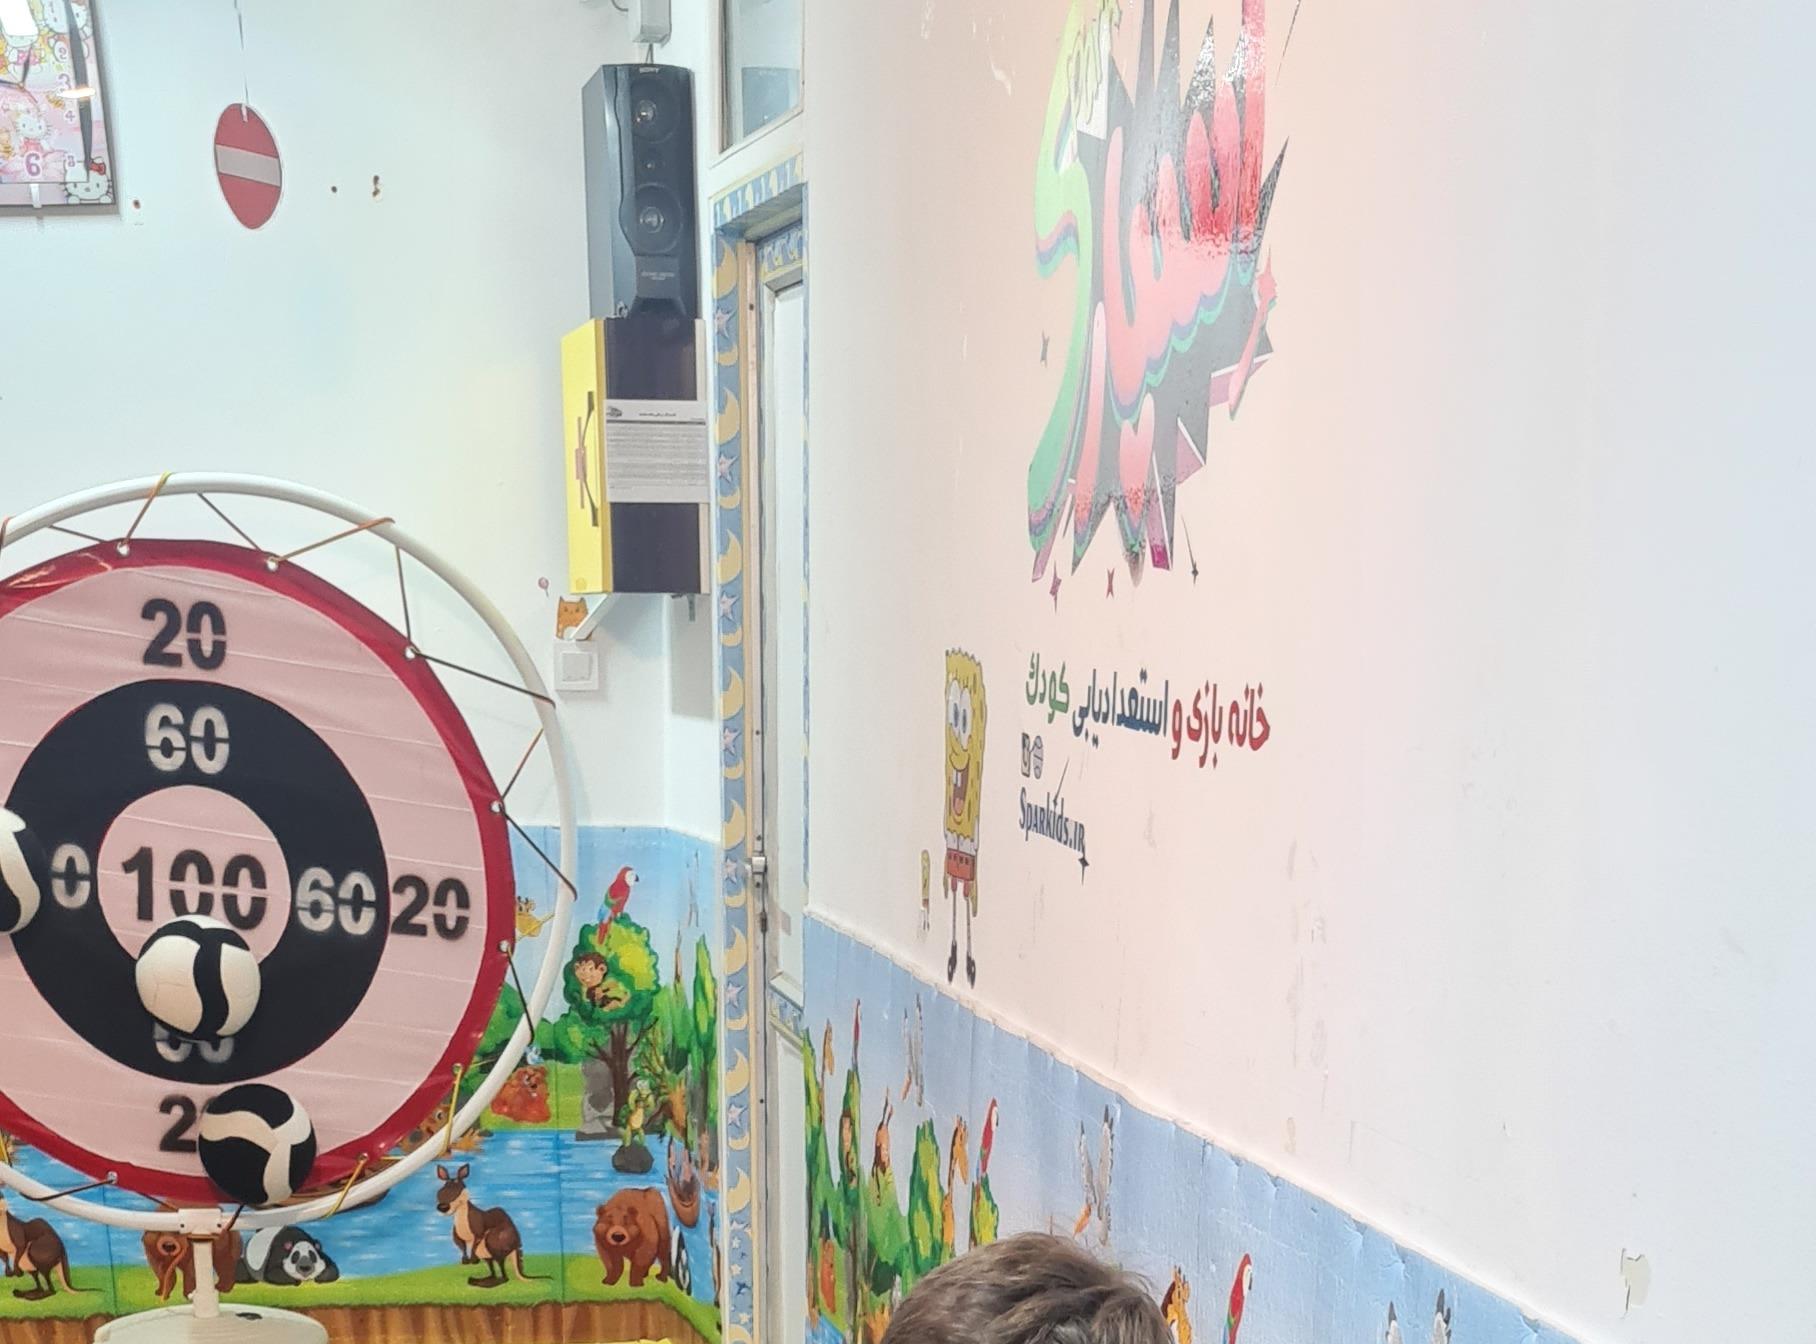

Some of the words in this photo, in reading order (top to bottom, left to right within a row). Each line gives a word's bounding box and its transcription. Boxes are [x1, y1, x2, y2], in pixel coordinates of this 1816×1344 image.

[65, 110, 75, 122] 4
[25, 152, 41, 177] 6
[141, 598, 227, 670] 20
[144, 703, 230, 774] 60
[1171, 698, 1183, 760] و
[1186, 680, 1224, 769] بازی
[1228, 681, 1271, 752] خانه
[120, 847, 271, 931] 100
[295, 867, 378, 936] 60
[391, 877, 471, 941] 20
